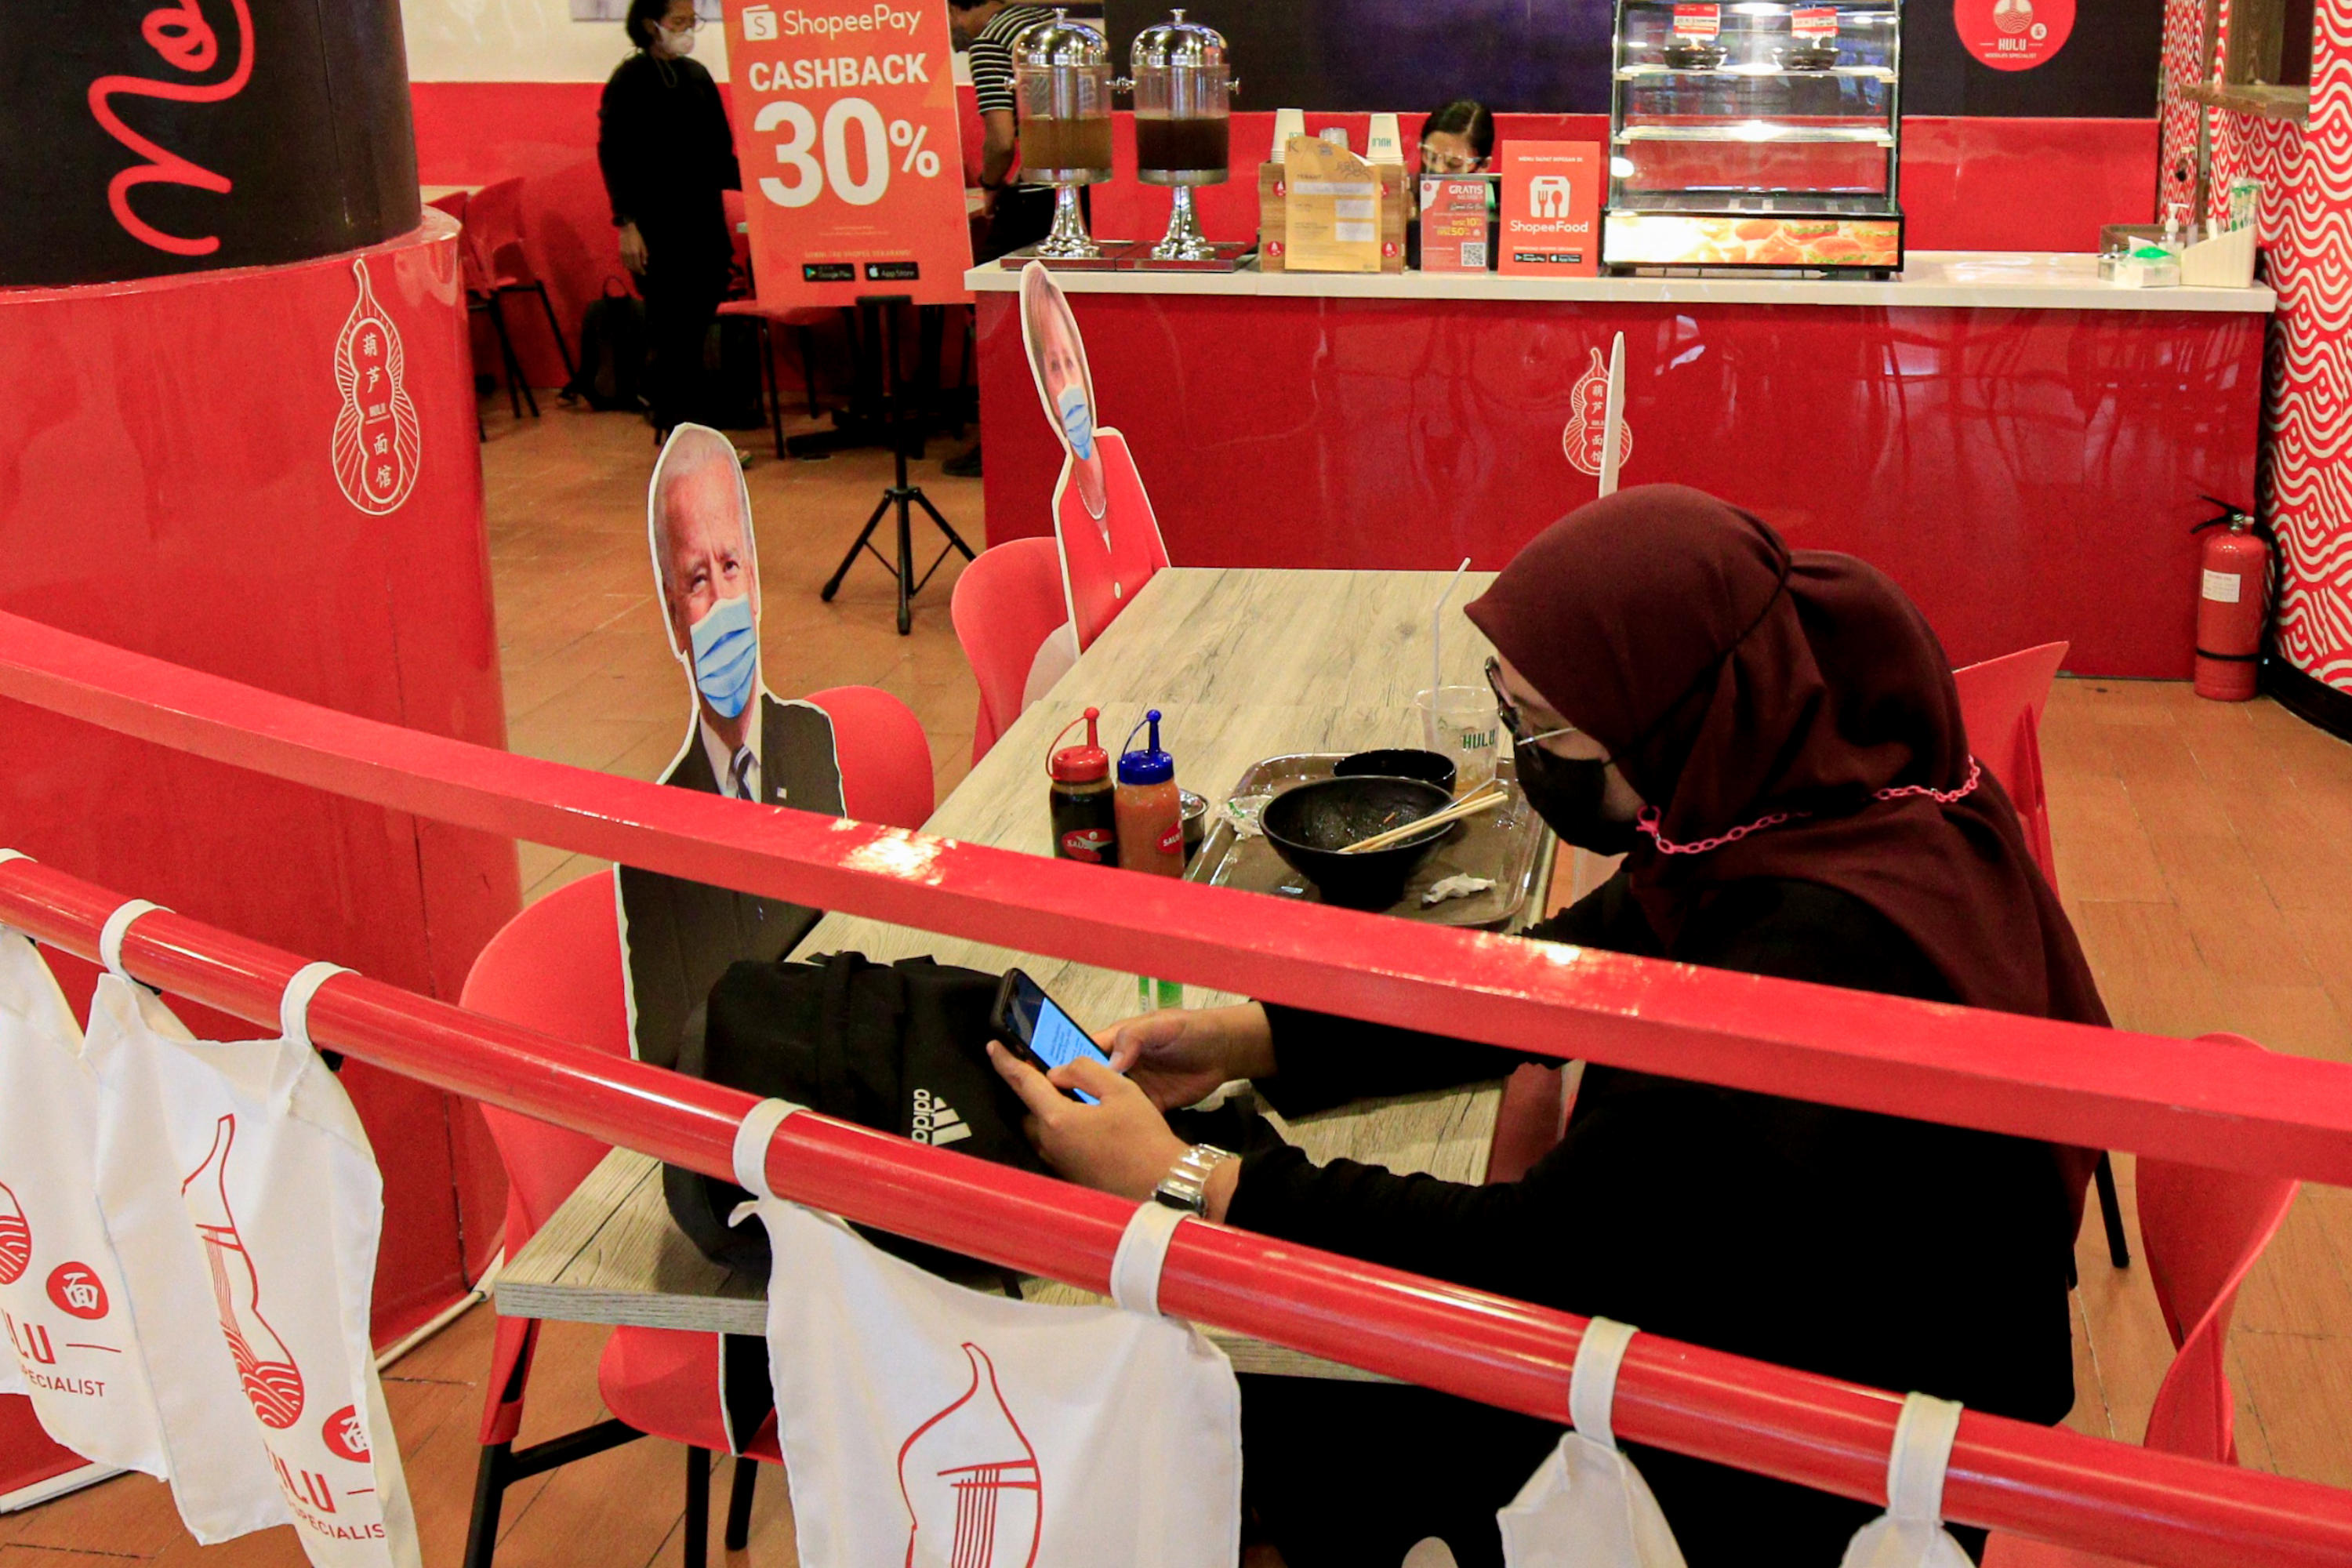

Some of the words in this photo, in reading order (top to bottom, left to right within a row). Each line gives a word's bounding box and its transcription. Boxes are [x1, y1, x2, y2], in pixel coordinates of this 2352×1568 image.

[783, 4, 922, 40] ShopeePay
[1998, 38, 2027, 51] HULU
[749, 53, 929, 92] CASHBACK
[753, 96, 941, 208] 30%
[1448, 184, 1484, 195] GRATIS
[1509, 220, 1588, 235] ShopeeFood
[881, 269, 896, 278] App
[1462, 728, 1496, 750] HULU
[911, 1088, 935, 1144] adida
[3, 1310, 56, 1365] LU
